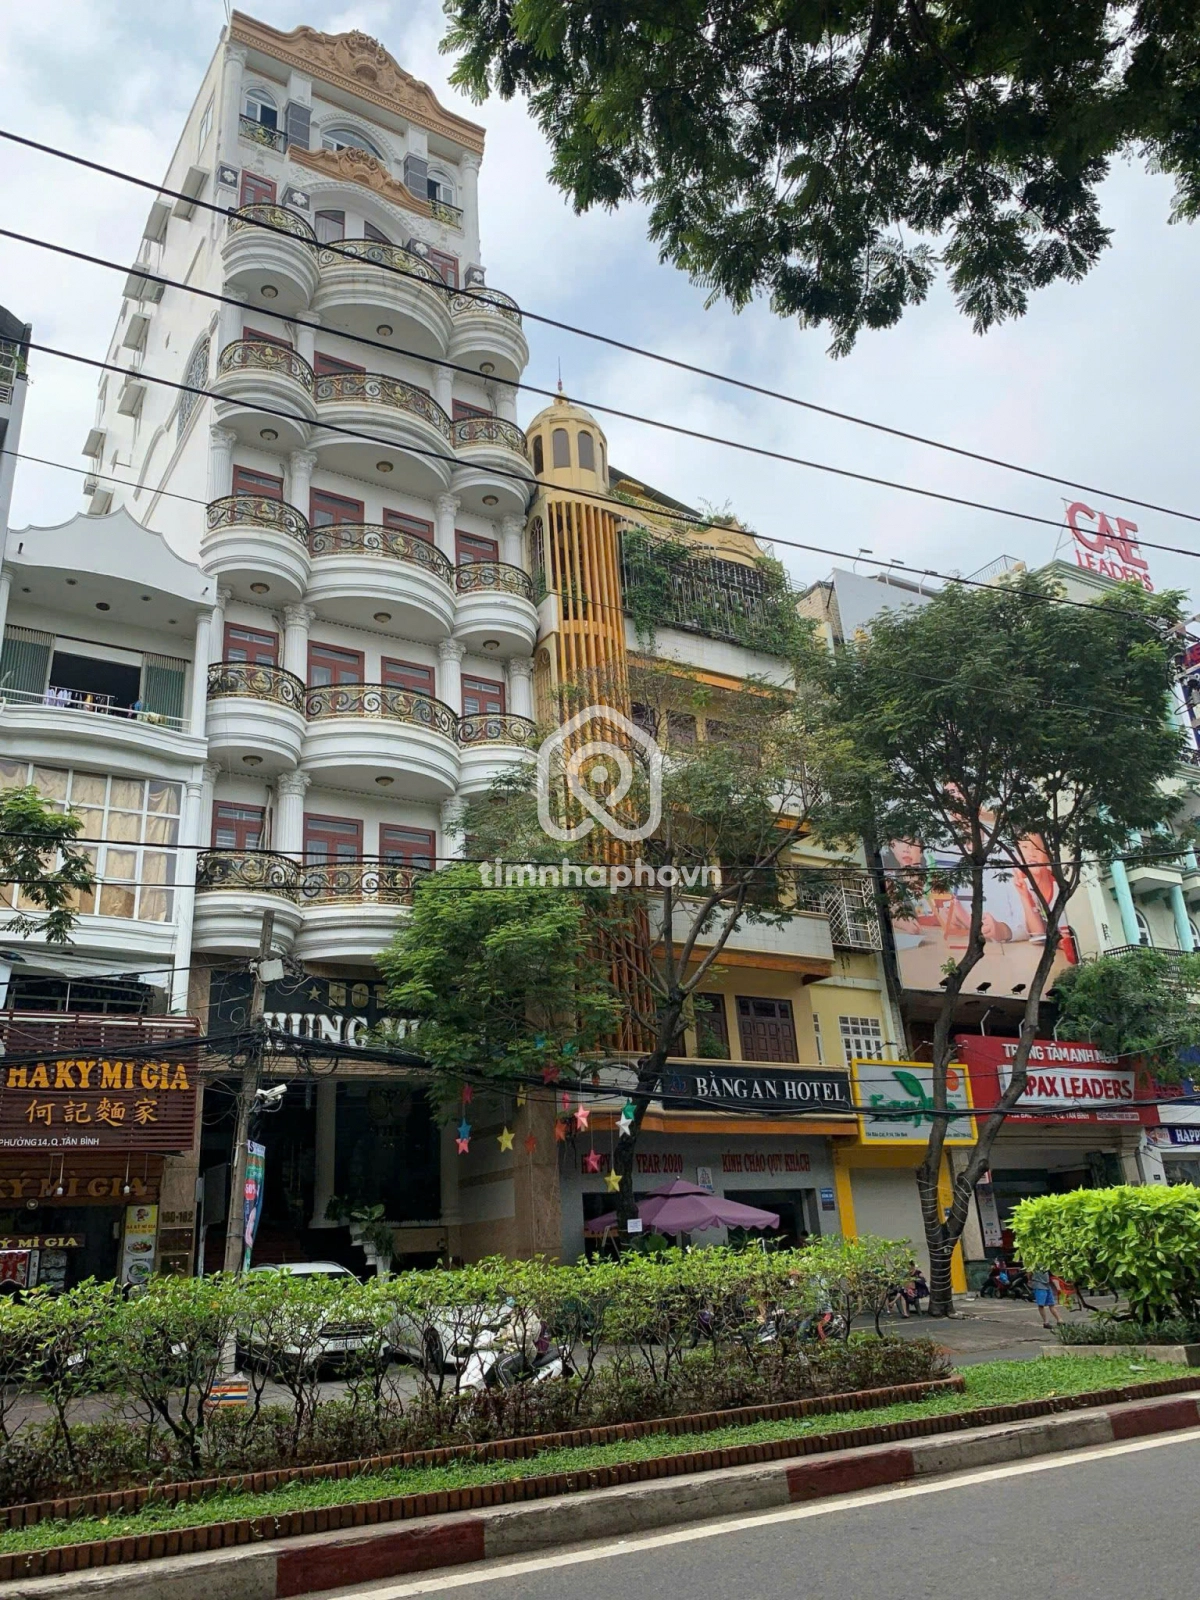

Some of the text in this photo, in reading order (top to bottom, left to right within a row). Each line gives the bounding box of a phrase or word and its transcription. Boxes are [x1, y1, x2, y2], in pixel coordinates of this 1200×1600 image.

[1067, 502, 1149, 570] CAE
[328, 982, 388, 1010] HOT
[1002, 1043, 1045, 1061] TRNG
[1045, 1042, 1071, 1063] TÂM
[1070, 1048, 1094, 1064] ANH
[140, 1062, 191, 1090] GIA
[751, 1080, 778, 1099] AN
[784, 1081, 846, 1101] HOTEL
[1060, 1077, 1133, 1100] LEADERS
[80, 1136, 100, 1146] BÌNH
[635, 1154, 661, 1174] YEAR
[662, 1154, 683, 1174] 2020
[87, 1177, 147, 1198] GIA
[18, 1236, 40, 1248] MÌ
[44, 1237, 78, 1248] GIA
